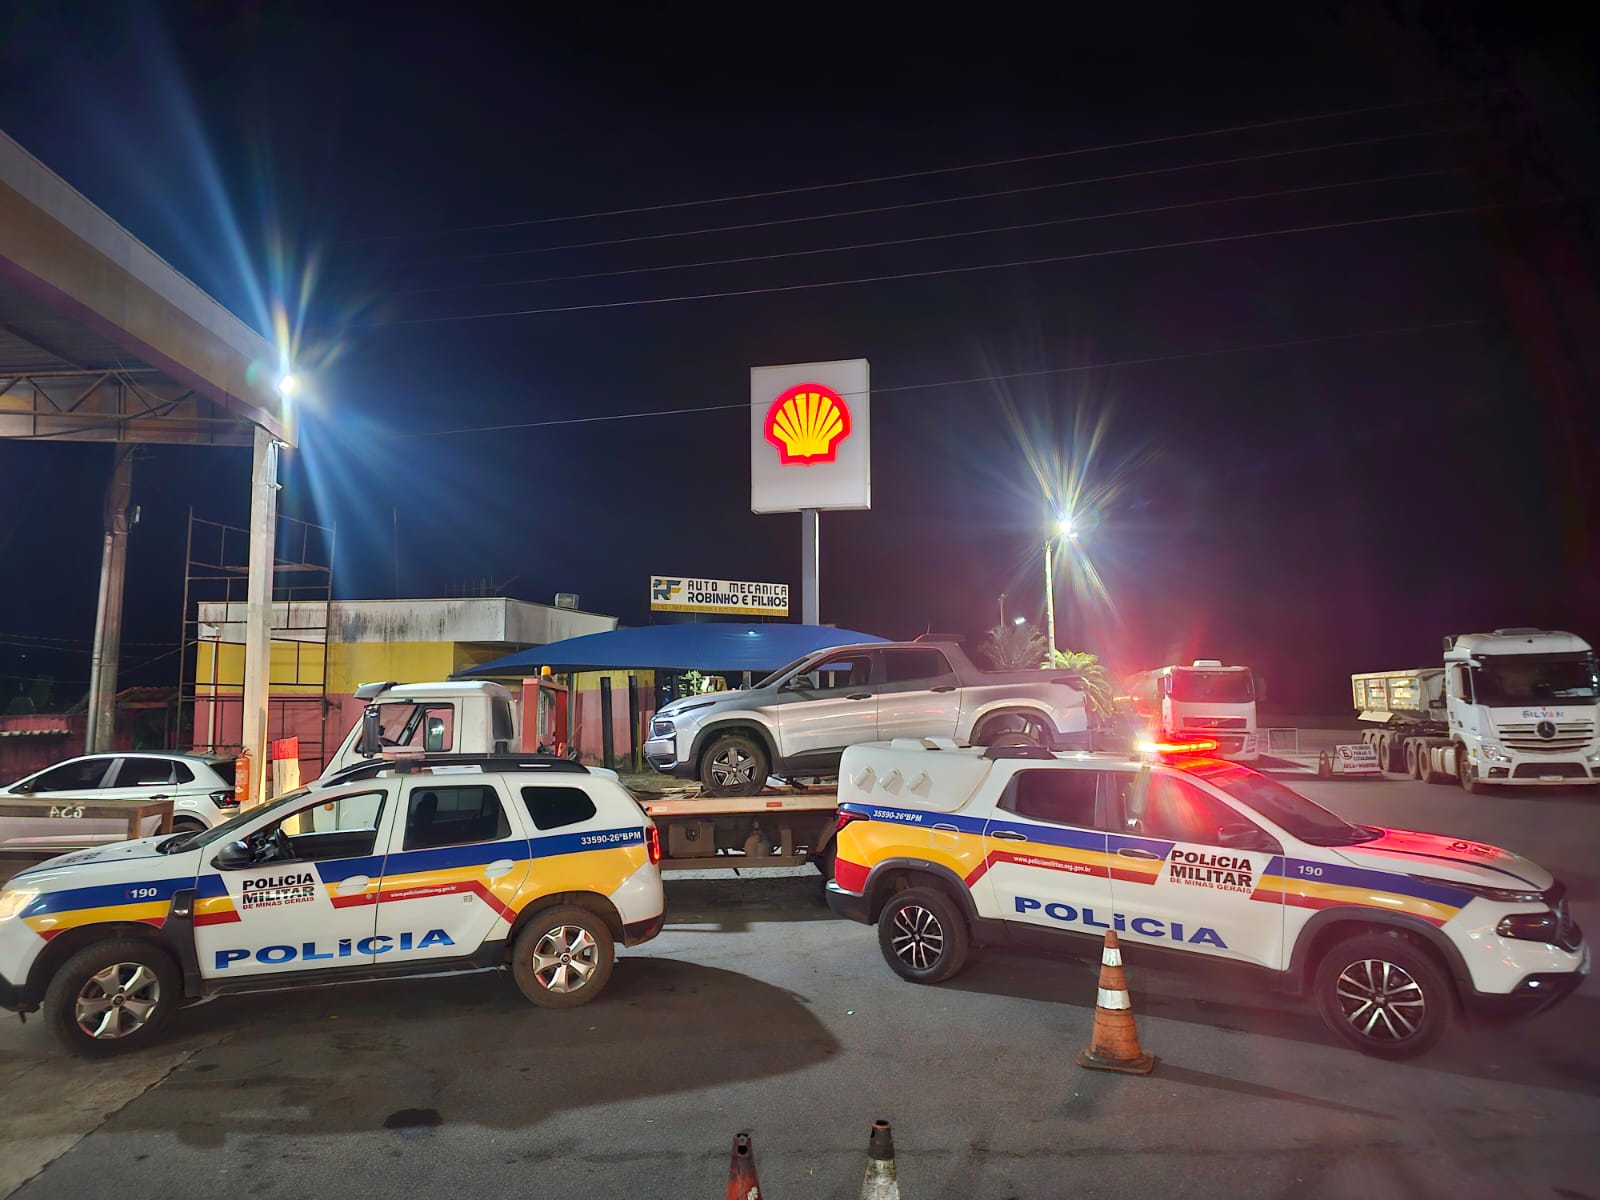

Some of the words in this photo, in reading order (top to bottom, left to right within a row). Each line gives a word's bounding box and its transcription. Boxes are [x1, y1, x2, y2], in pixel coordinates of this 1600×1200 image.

[688, 580, 717, 591] AUTO
[687, 592, 739, 605] ROBINHO
[742, 594, 749, 605] E
[751, 595, 787, 607] FILHOS
[1170, 864, 1252, 888] MILITAR
[1297, 865, 1323, 876] 190
[130, 887, 157, 898] 190
[1170, 877, 1185, 885] DE
[1188, 879, 1214, 889] MINAS
[1216, 884, 1252, 895] GERAIS
[242, 886, 315, 904] MILITAR
